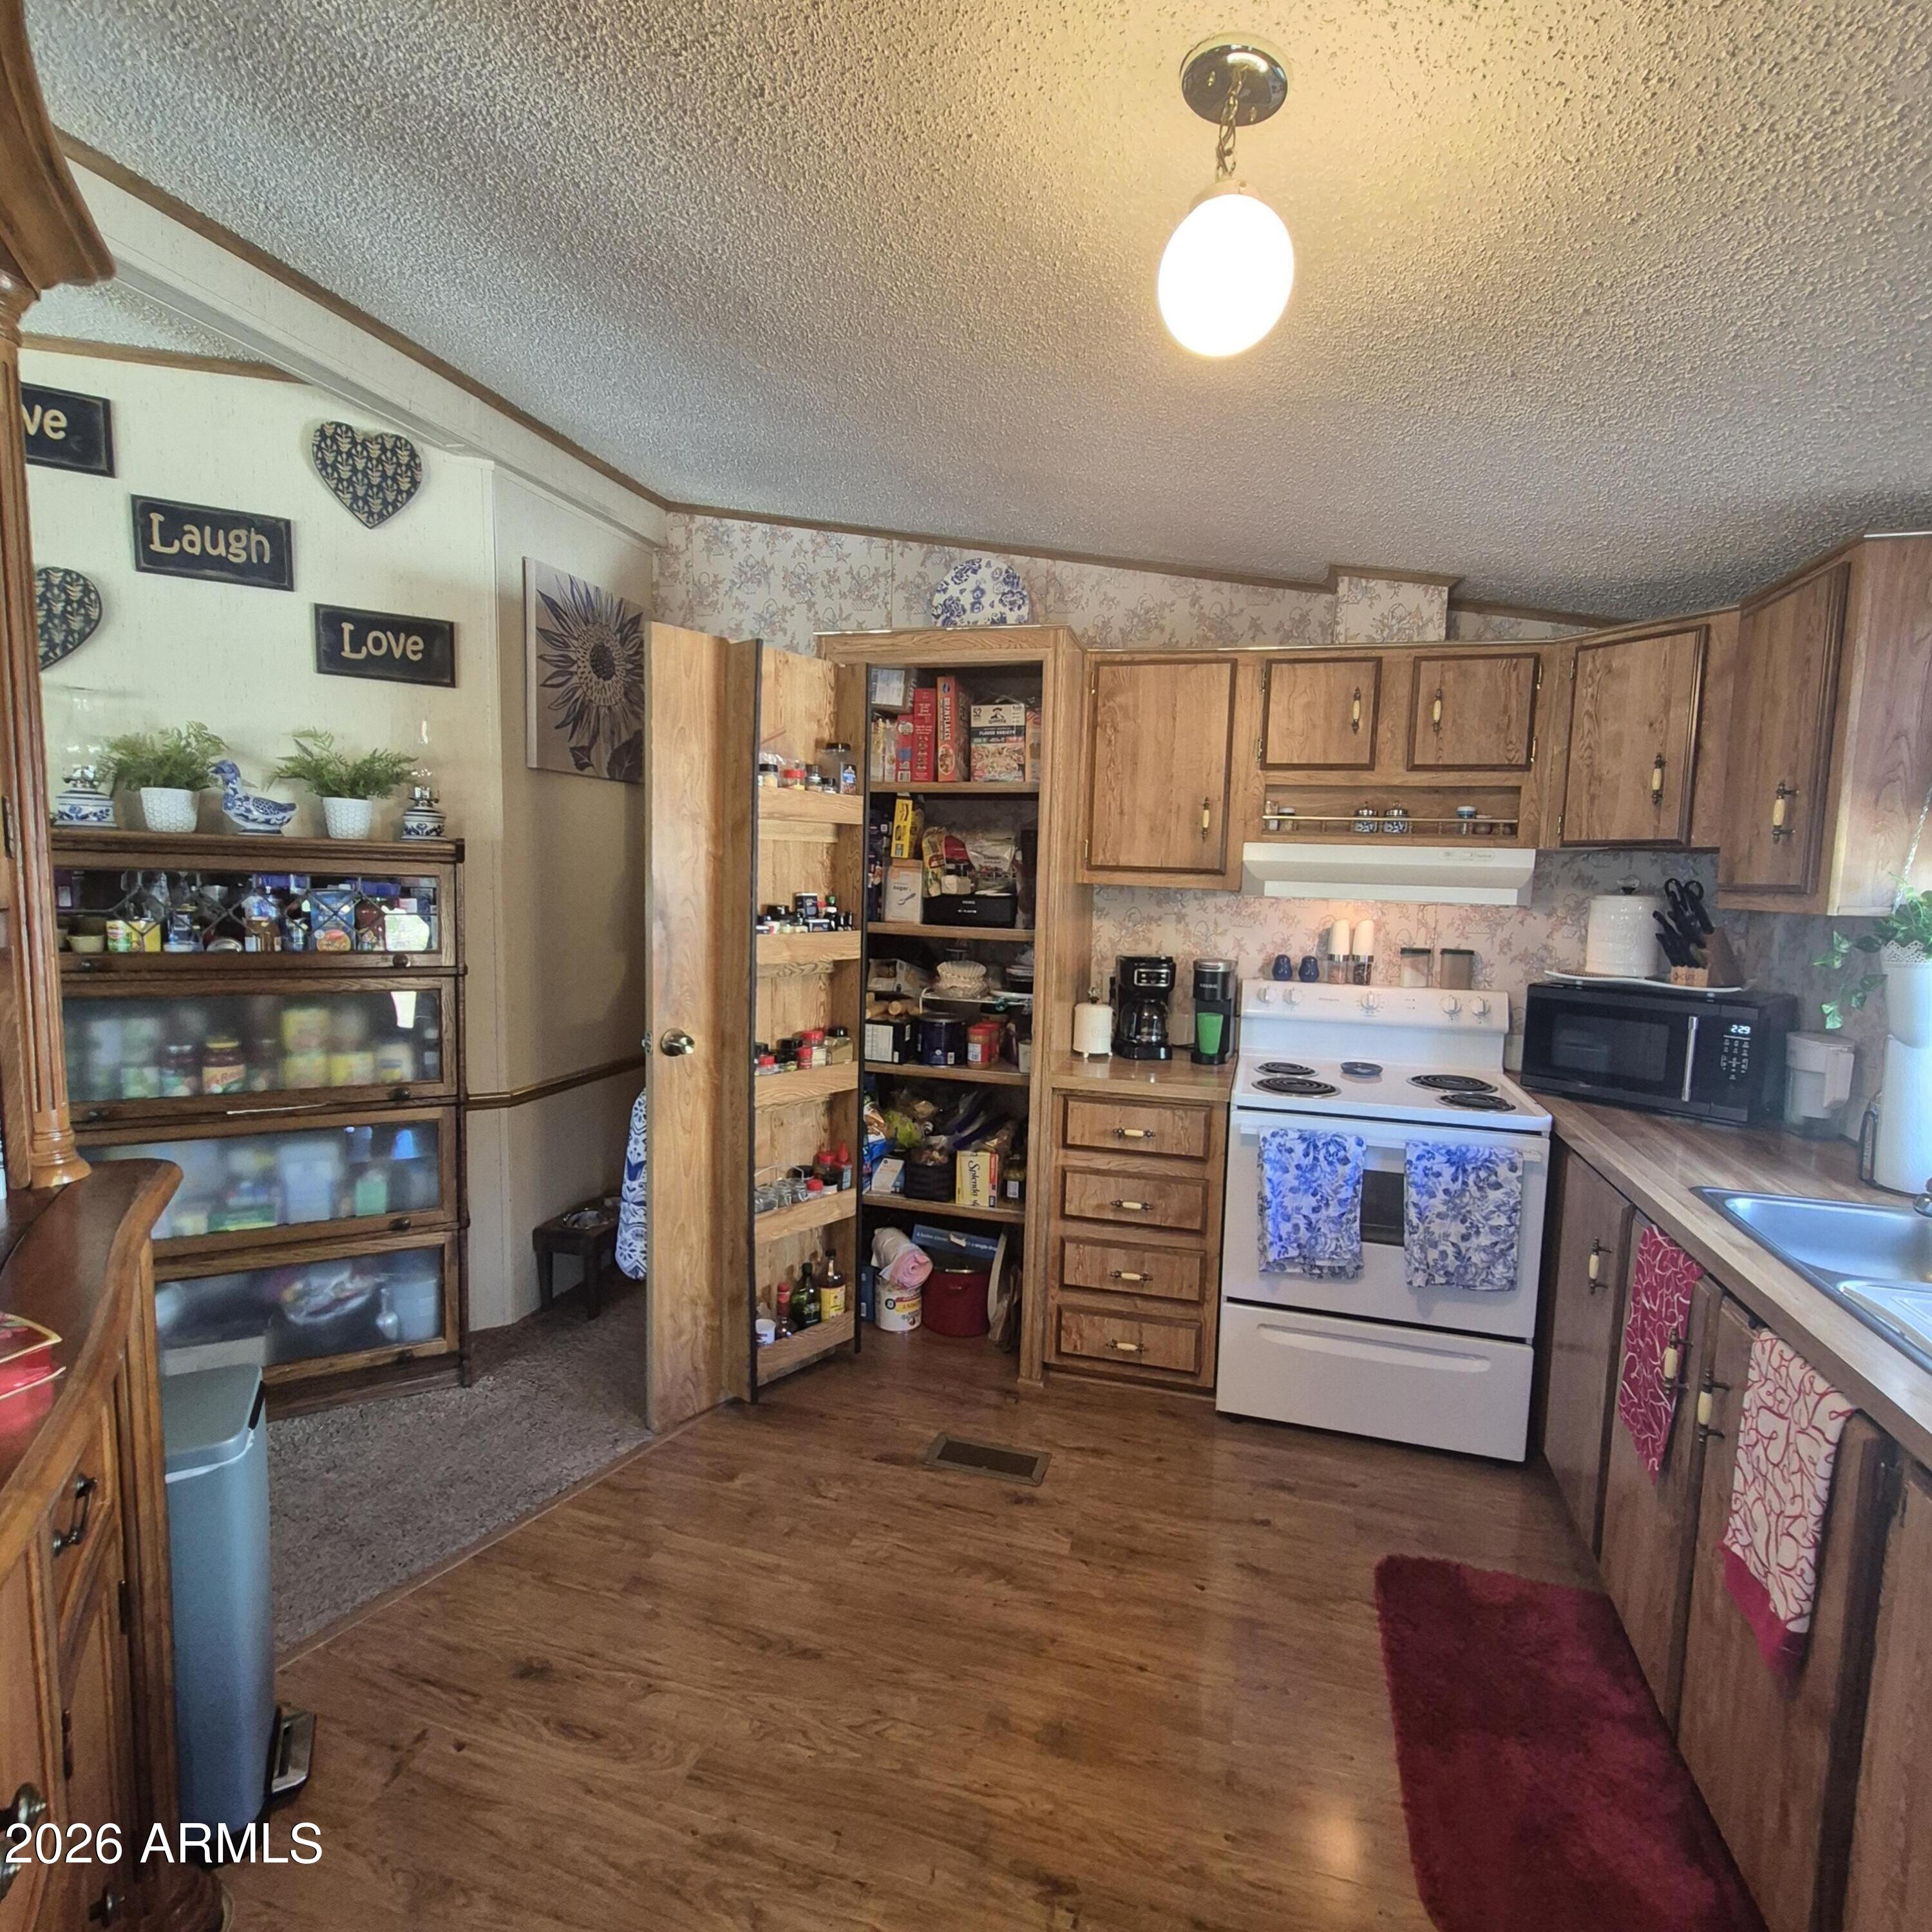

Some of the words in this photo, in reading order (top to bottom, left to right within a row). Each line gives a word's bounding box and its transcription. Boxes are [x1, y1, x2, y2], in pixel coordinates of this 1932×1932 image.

[21, 402, 68, 440] ve
[149, 512, 270, 564] Laugh
[341, 621, 424, 661] Love
[972, 708, 981, 717] 52
[968, 1160, 980, 1197] Splenda
